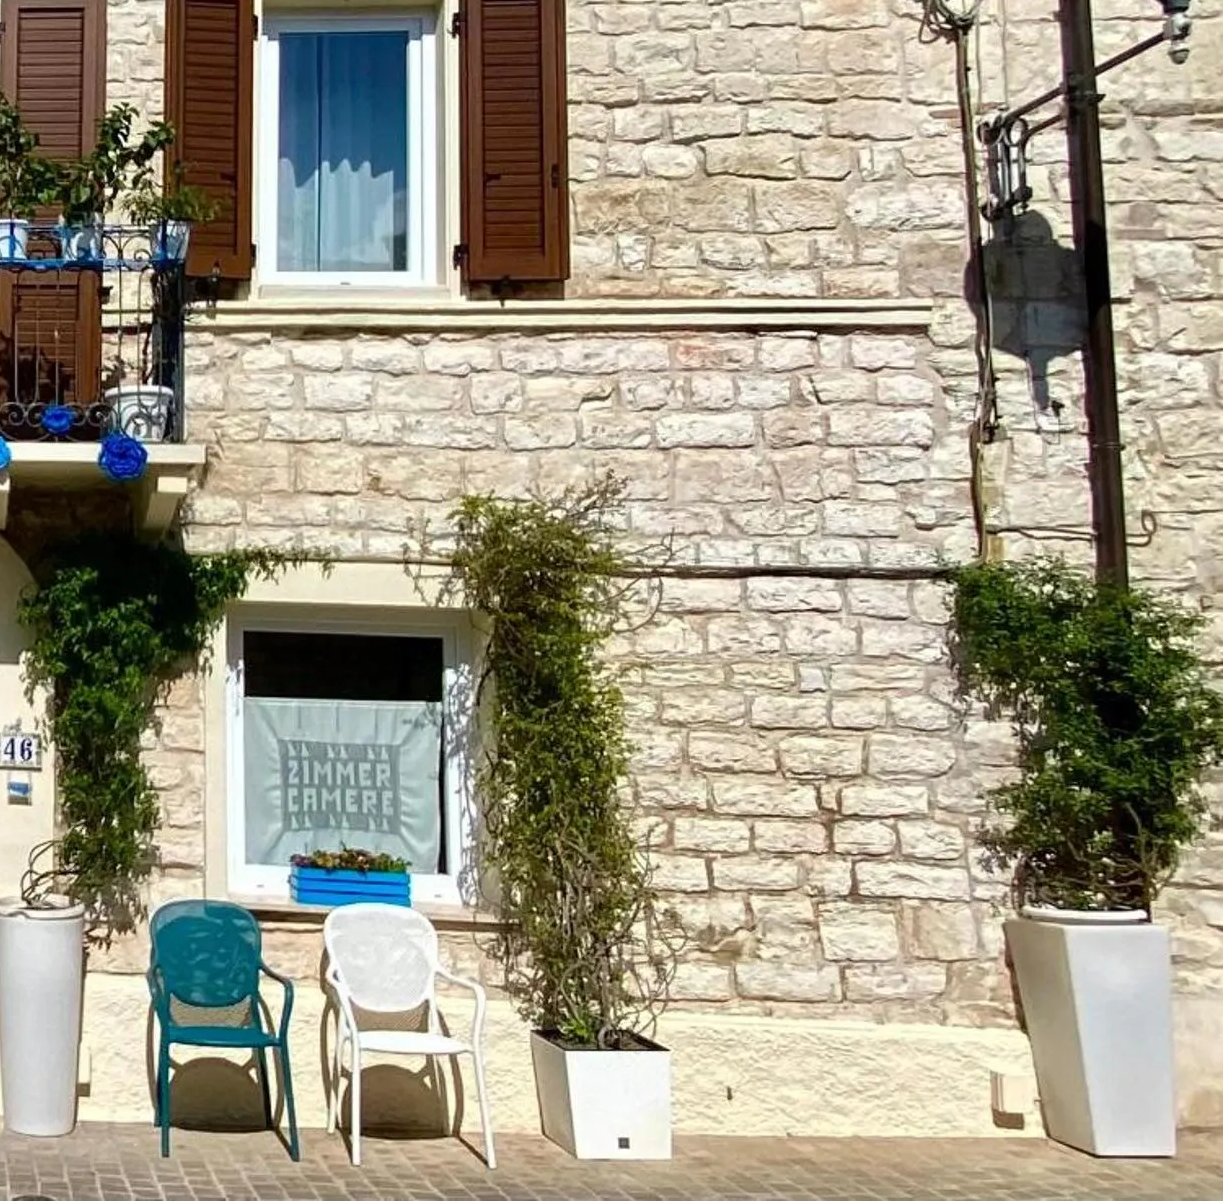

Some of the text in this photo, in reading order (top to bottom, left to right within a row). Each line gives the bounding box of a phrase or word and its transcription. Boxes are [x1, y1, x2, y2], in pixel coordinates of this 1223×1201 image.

[3, 738, 33, 761] 46
[288, 760, 391, 787] ZIMMER
[288, 788, 394, 814] CAMERE
